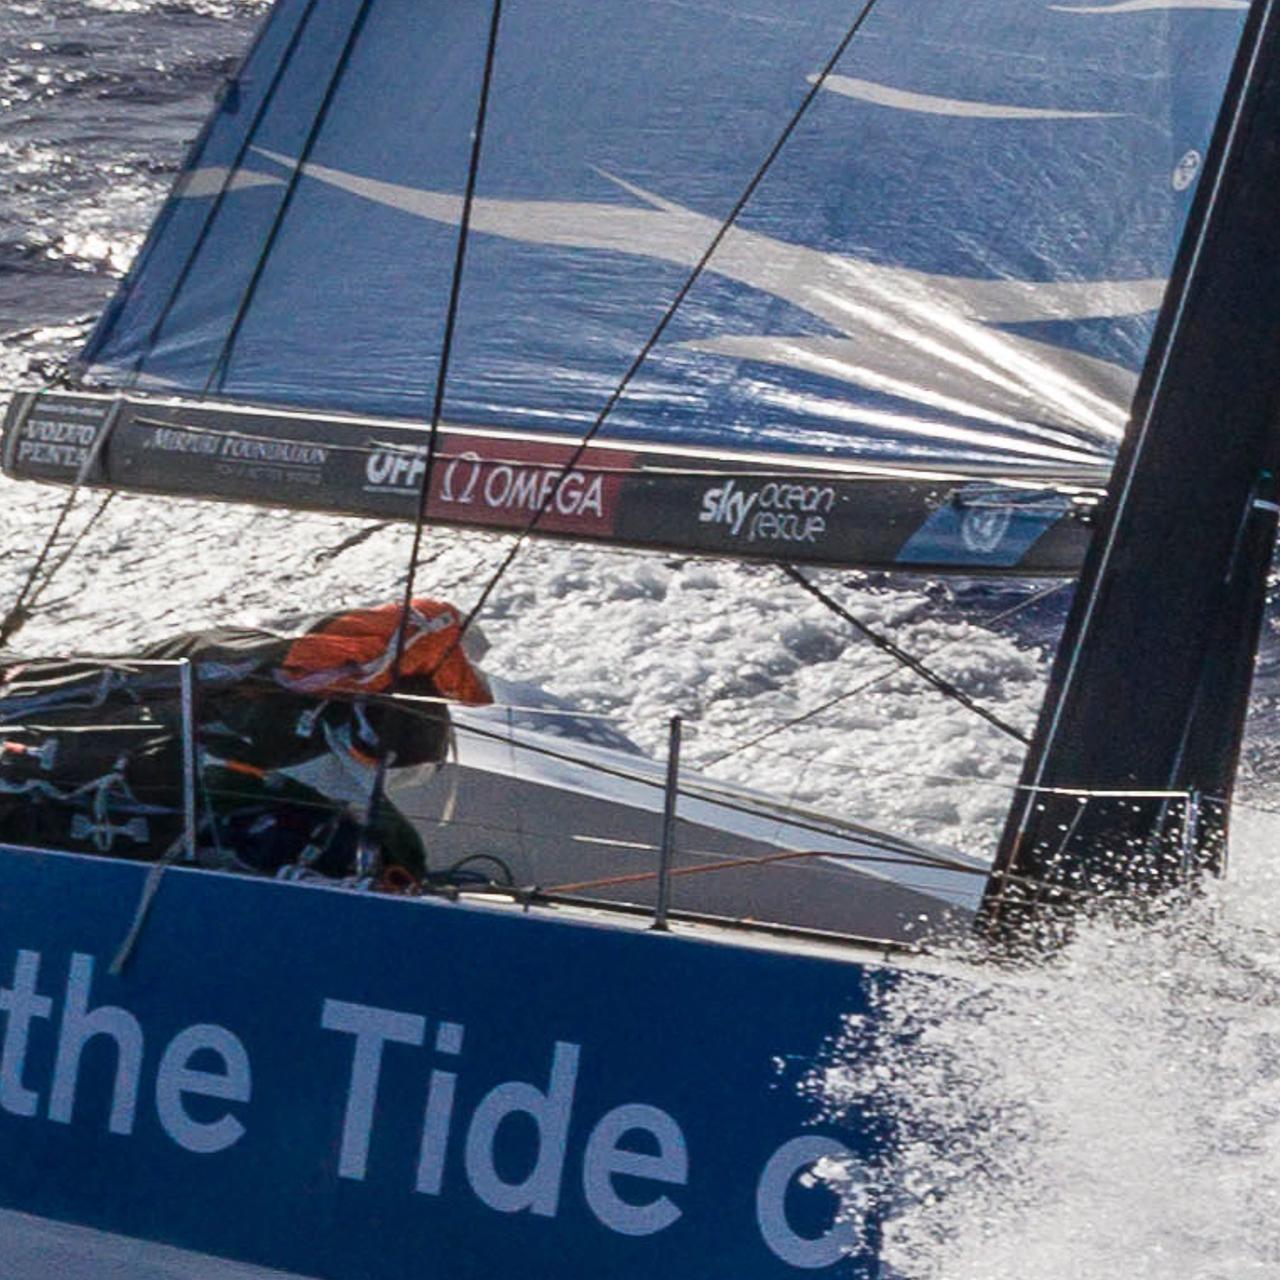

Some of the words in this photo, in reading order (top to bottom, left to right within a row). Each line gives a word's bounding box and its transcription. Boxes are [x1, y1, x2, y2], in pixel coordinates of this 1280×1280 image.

[484, 466, 603, 518] OMEGA
[699, 480, 758, 536] sky
[759, 483, 835, 514] ocean
[748, 512, 826, 543] rescue
[0, 949, 252, 1153] the
[320, 998, 689, 1236] Tide
